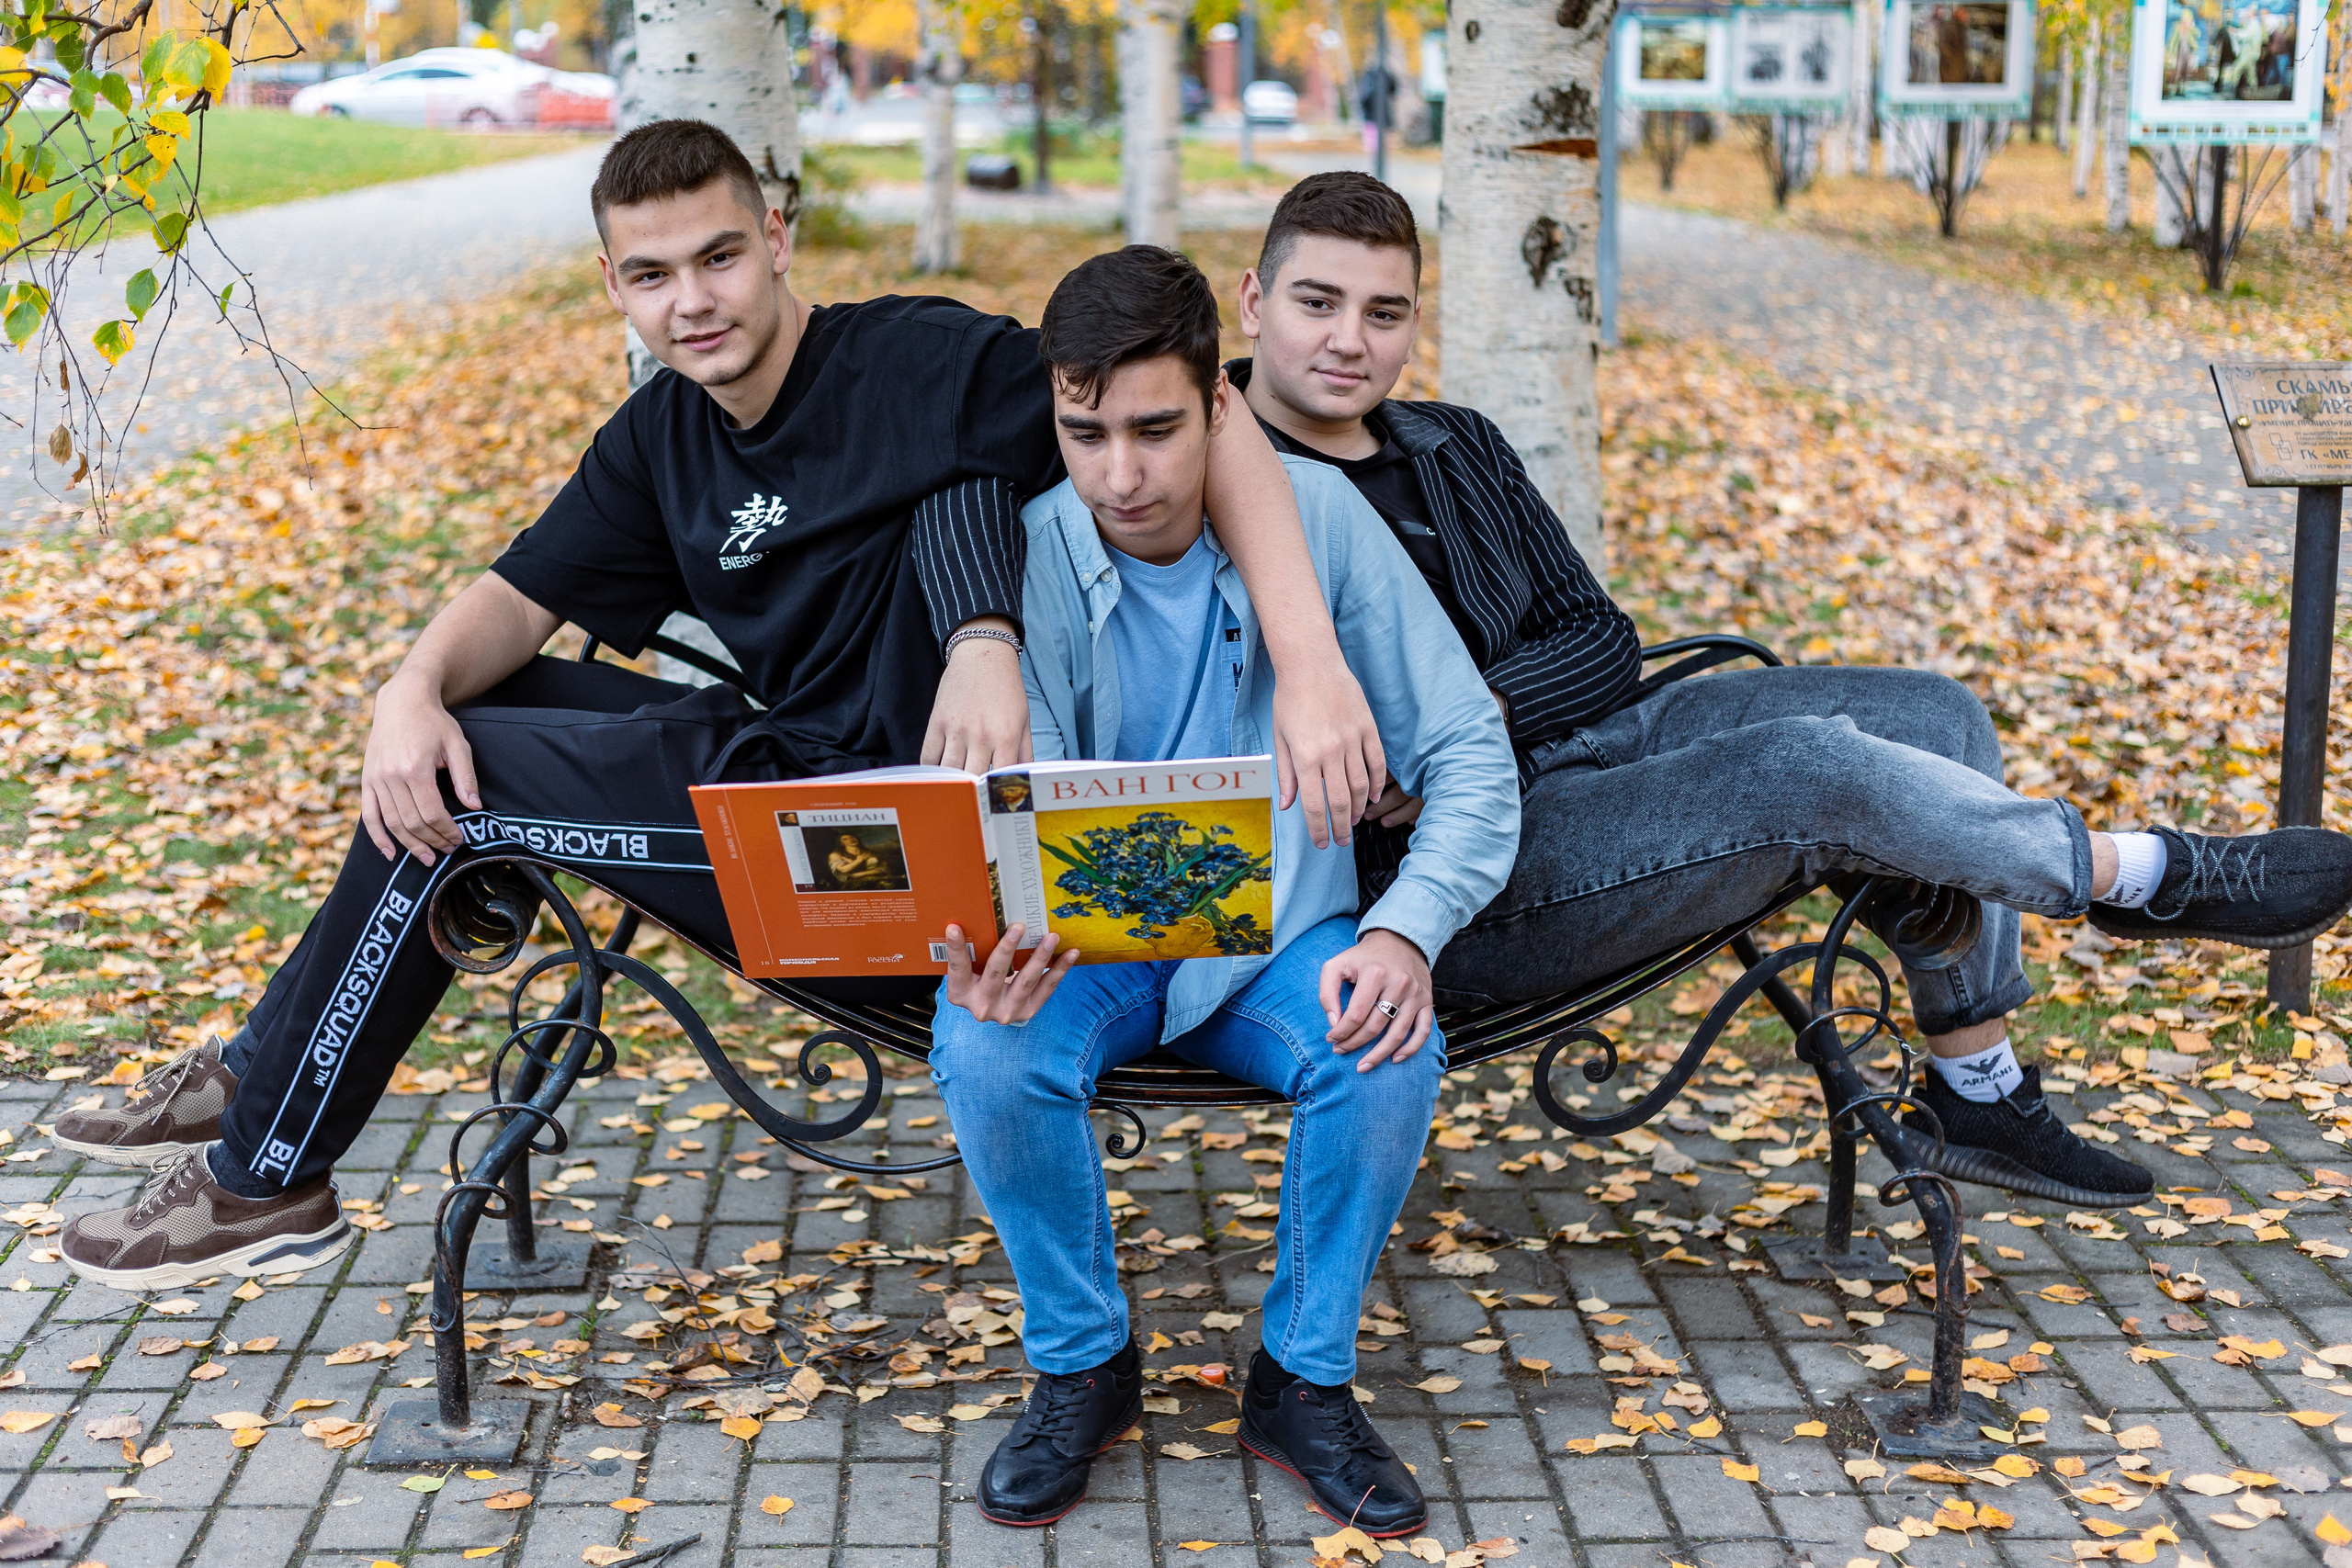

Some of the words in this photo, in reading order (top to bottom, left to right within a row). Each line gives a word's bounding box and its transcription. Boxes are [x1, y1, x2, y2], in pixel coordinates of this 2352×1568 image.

[2276, 378, 2352, 395] СКАМЬ
[2253, 399, 2352, 414] ПРИИРЕ
[2300, 449, 2318, 459] ГК
[2323, 449, 2352, 459] «МЕ
[718, 551, 770, 570] ENERG
[1049, 775, 1149, 801] ВАН
[1164, 770, 1257, 794] ГОГ
[808, 812, 887, 824] ТИЦИАН
[1013, 815, 1039, 892] ХУДОЖНИКИ
[1024, 893, 1044, 946] ВЕЛИКИЕ
[1962, 1065, 2014, 1087] ARMANI
[255, 1138, 296, 1179] BL
